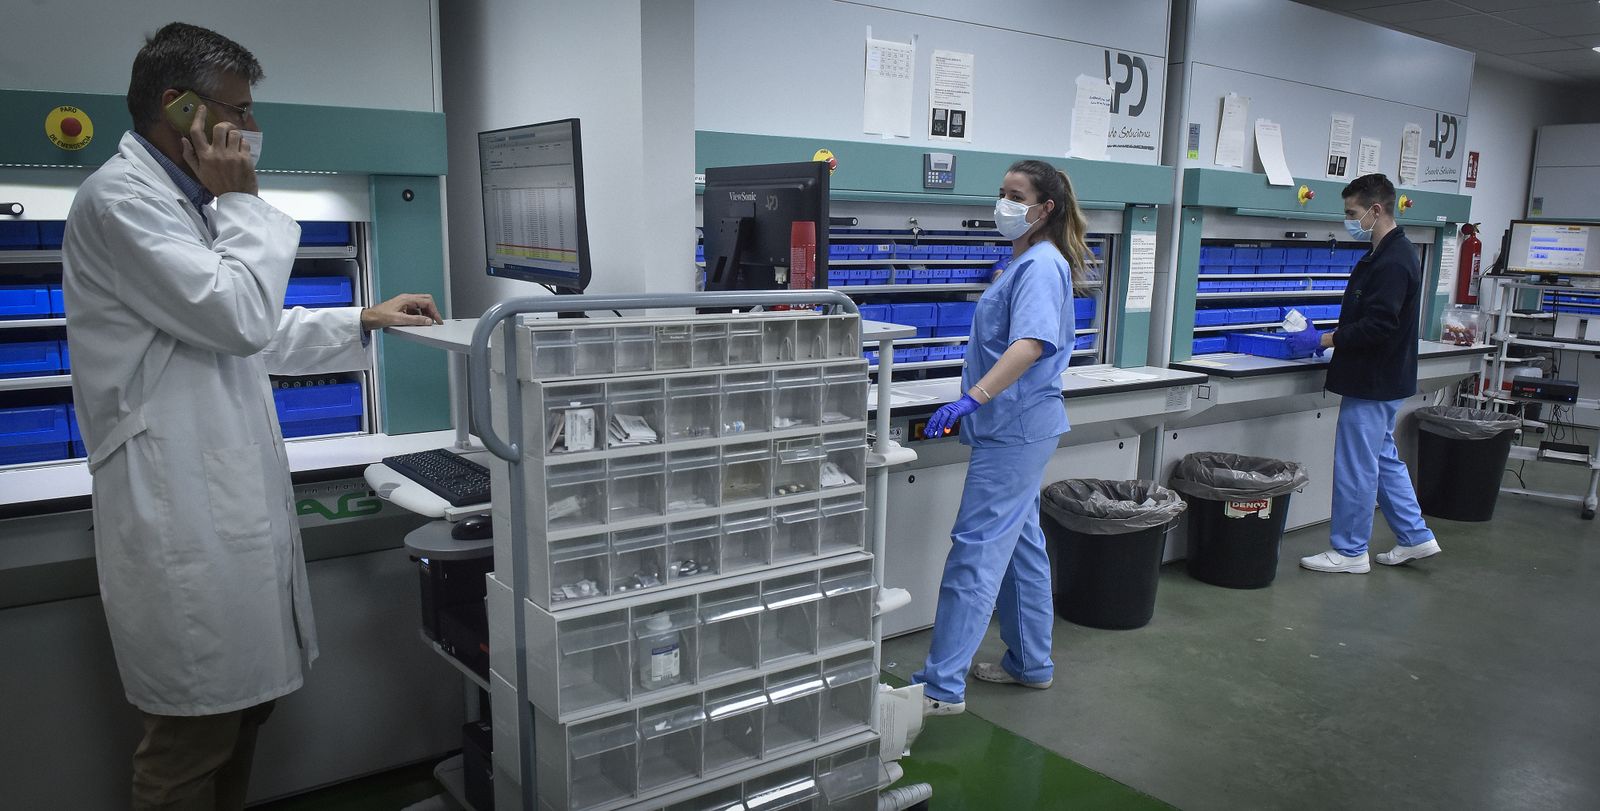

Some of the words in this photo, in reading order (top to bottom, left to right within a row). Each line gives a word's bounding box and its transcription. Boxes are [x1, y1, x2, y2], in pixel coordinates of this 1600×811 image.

[60, 106, 78, 114] PARO
[50, 133, 58, 142] DE
[57, 135, 92, 150] EMERGENCIA
[729, 191, 757, 202] ViewSonic
[1232, 501, 1267, 509] DENOX
